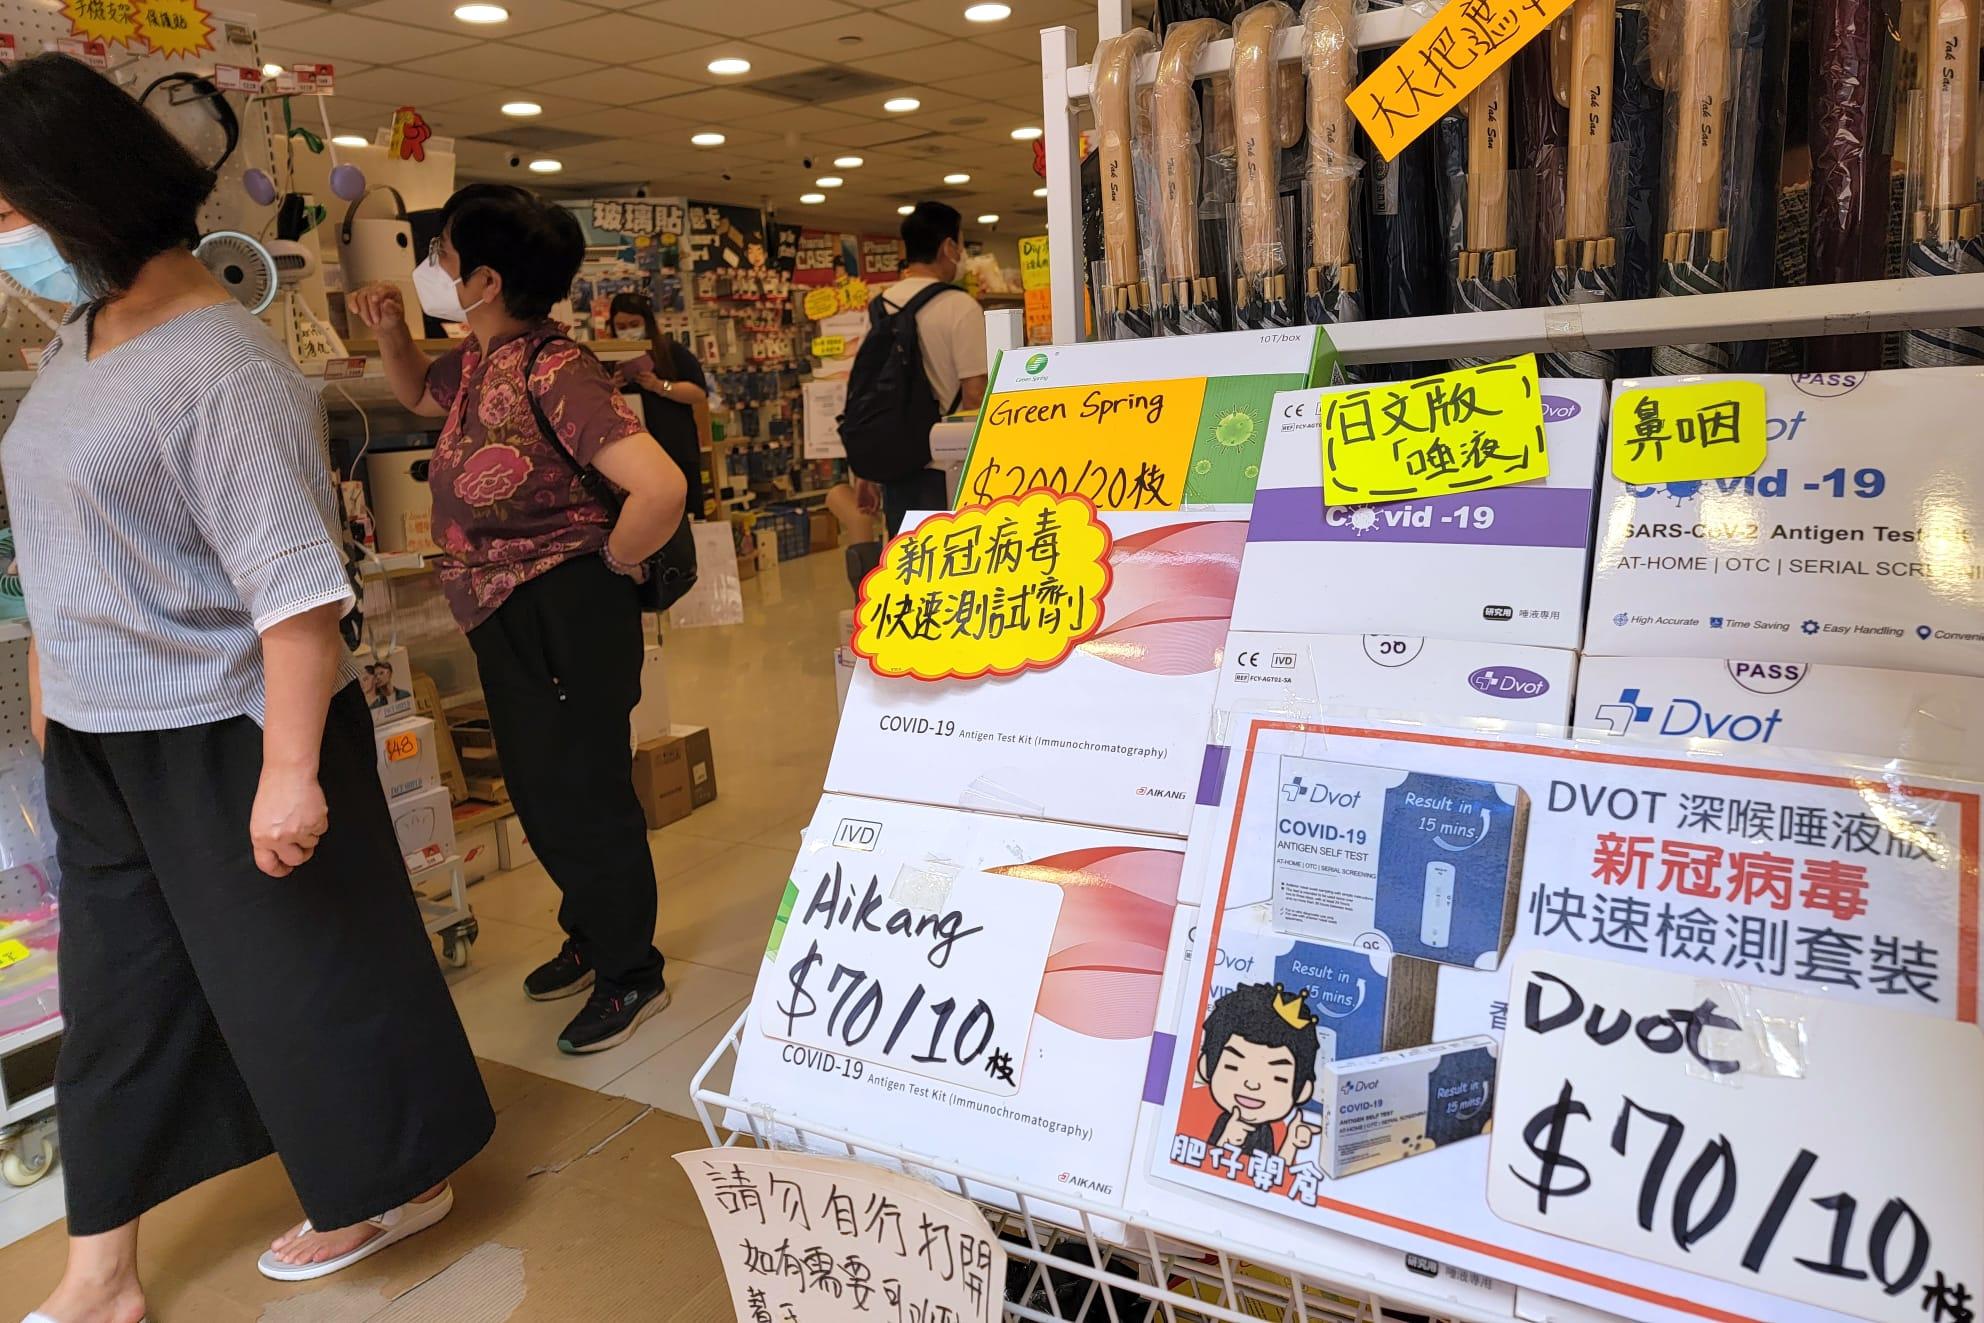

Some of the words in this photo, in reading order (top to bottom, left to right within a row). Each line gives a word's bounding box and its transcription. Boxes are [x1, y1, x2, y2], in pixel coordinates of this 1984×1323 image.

[1588, 113, 1600, 136] San
[1701, 121, 1712, 146] San
[1486, 126, 1497, 149] San
[592, 200, 684, 237] 玻璃貼
[796, 249, 833, 270] CASE
[865, 254, 900, 273] CASE
[1259, 334, 1301, 345] 10T/box
[1796, 372, 1857, 388] PASS
[989, 400, 1066, 426] Green
[1079, 390, 1165, 424] Spring
[1340, 383, 1503, 445] 日文版
[1624, 396, 1741, 462] 鼻咽
[1803, 467, 1887, 499] -19
[1441, 507, 1495, 529] -19
[1770, 524, 1864, 544] Antigen
[896, 507, 1062, 585] 新冠病毒
[1616, 556, 1707, 571] AT-HOME
[1725, 558, 1770, 572] OTC
[1789, 558, 1869, 576] SERIAL
[870, 577, 1084, 641] 快速測試劑
[1630, 615, 1653, 626] High
[1655, 616, 1699, 627] Accurate
[1725, 619, 1750, 629] Time
[1752, 620, 1790, 632] Saving
[1822, 623, 1851, 635] Easy
[1853, 625, 1904, 638] Handling
[1275, 656, 1293, 666] IVD
[1735, 661, 1800, 682] PASS
[1499, 676, 1545, 696] Dvot
[1659, 699, 1783, 744] Dvot
[878, 714, 956, 738] COVID-19
[958, 728, 994, 743] Antigen
[997, 732, 1016, 744] Test
[1018, 733, 1032, 746] Kit
[1033, 736, 1169, 760] (Immunochromatography)
[1146, 787, 1187, 801] AIKANG
[1310, 783, 1362, 809] Dvot
[1405, 792, 1453, 813] Result
[1458, 799, 1473, 815] in
[1548, 780, 1667, 824] DVOT
[840, 824, 875, 845] IVD
[1279, 818, 1367, 845] COVID-19
[1418, 816, 1436, 832] 15
[1440, 820, 1479, 840] mins.
[1277, 841, 1318, 854] ANTIGEN
[1319, 846, 1342, 858] SELF
[1345, 850, 1369, 862] TEST
[1591, 831, 1870, 922] 新冠病毒
[803, 861, 984, 969] Aikang
[1528, 882, 1941, 1005] 快速檢測套裝
[1291, 960, 1333, 980] Result
[1338, 969, 1350, 984] in
[1322, 990, 1356, 1007] mins.
[782, 1044, 864, 1080] COVID-19
[867, 1072, 906, 1093] Antigen
[908, 1083, 930, 1099] Test
[931, 1088, 947, 1103] Kit
[948, 1091, 1094, 1142] (Immunochromatography)
[1437, 1083, 1467, 1098] Result
[1339, 1099, 1383, 1114] COVID-19
[1069, 1175, 1113, 1195] AIKANG
[703, 1160, 991, 1323] 請勿自行打開
